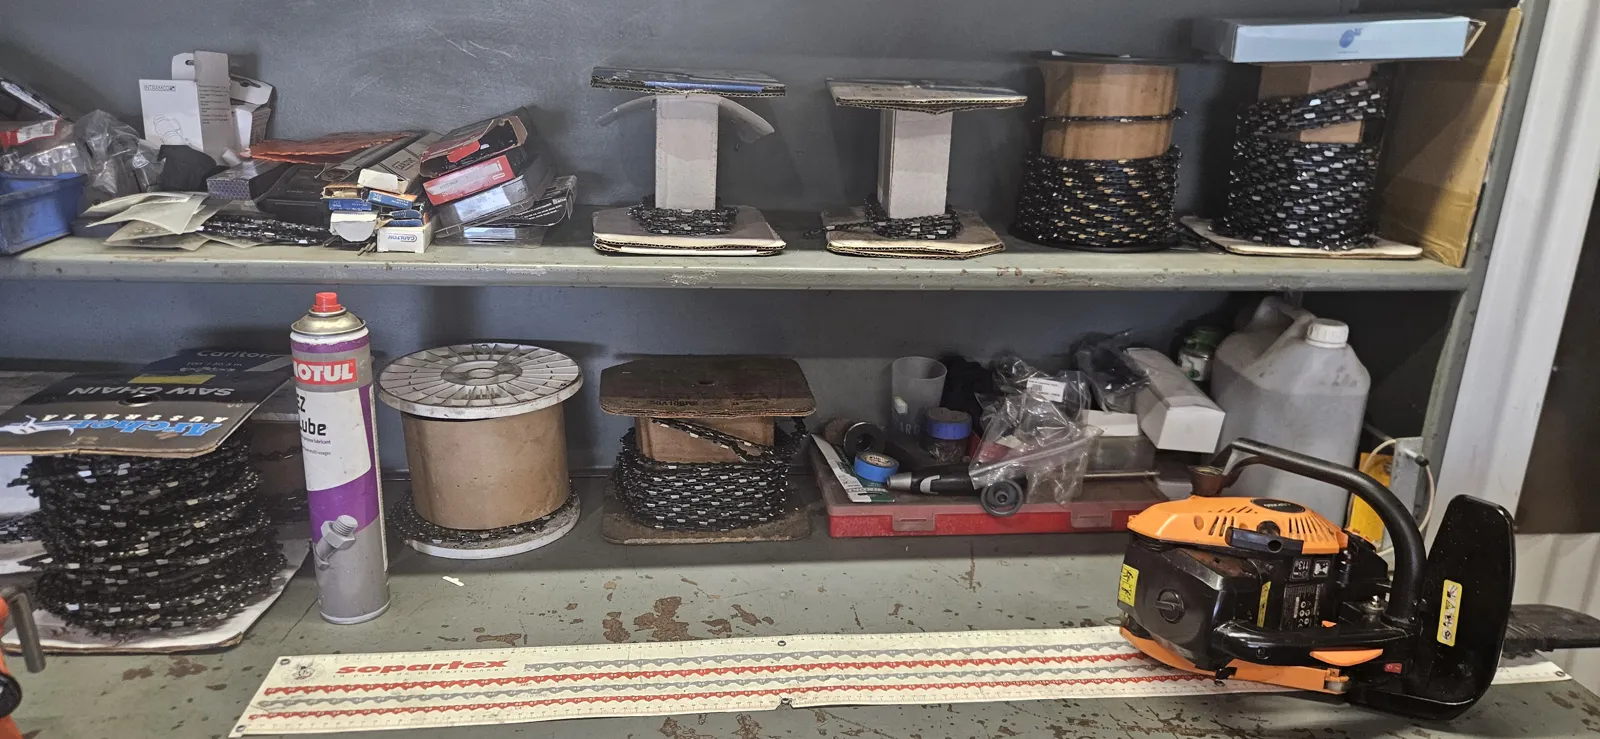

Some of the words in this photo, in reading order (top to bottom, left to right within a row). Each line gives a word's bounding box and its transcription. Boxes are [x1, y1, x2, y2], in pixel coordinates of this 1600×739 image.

[387, 234, 416, 242] CARLTON
[67, 386, 163, 396] CHAIN
[166, 387, 235, 396] SAW
[42, 413, 229, 423] AUSTRALIA
[75, 419, 222, 437] Archer
[299, 417, 327, 436] ube
[335, 660, 510, 674] sopartex
